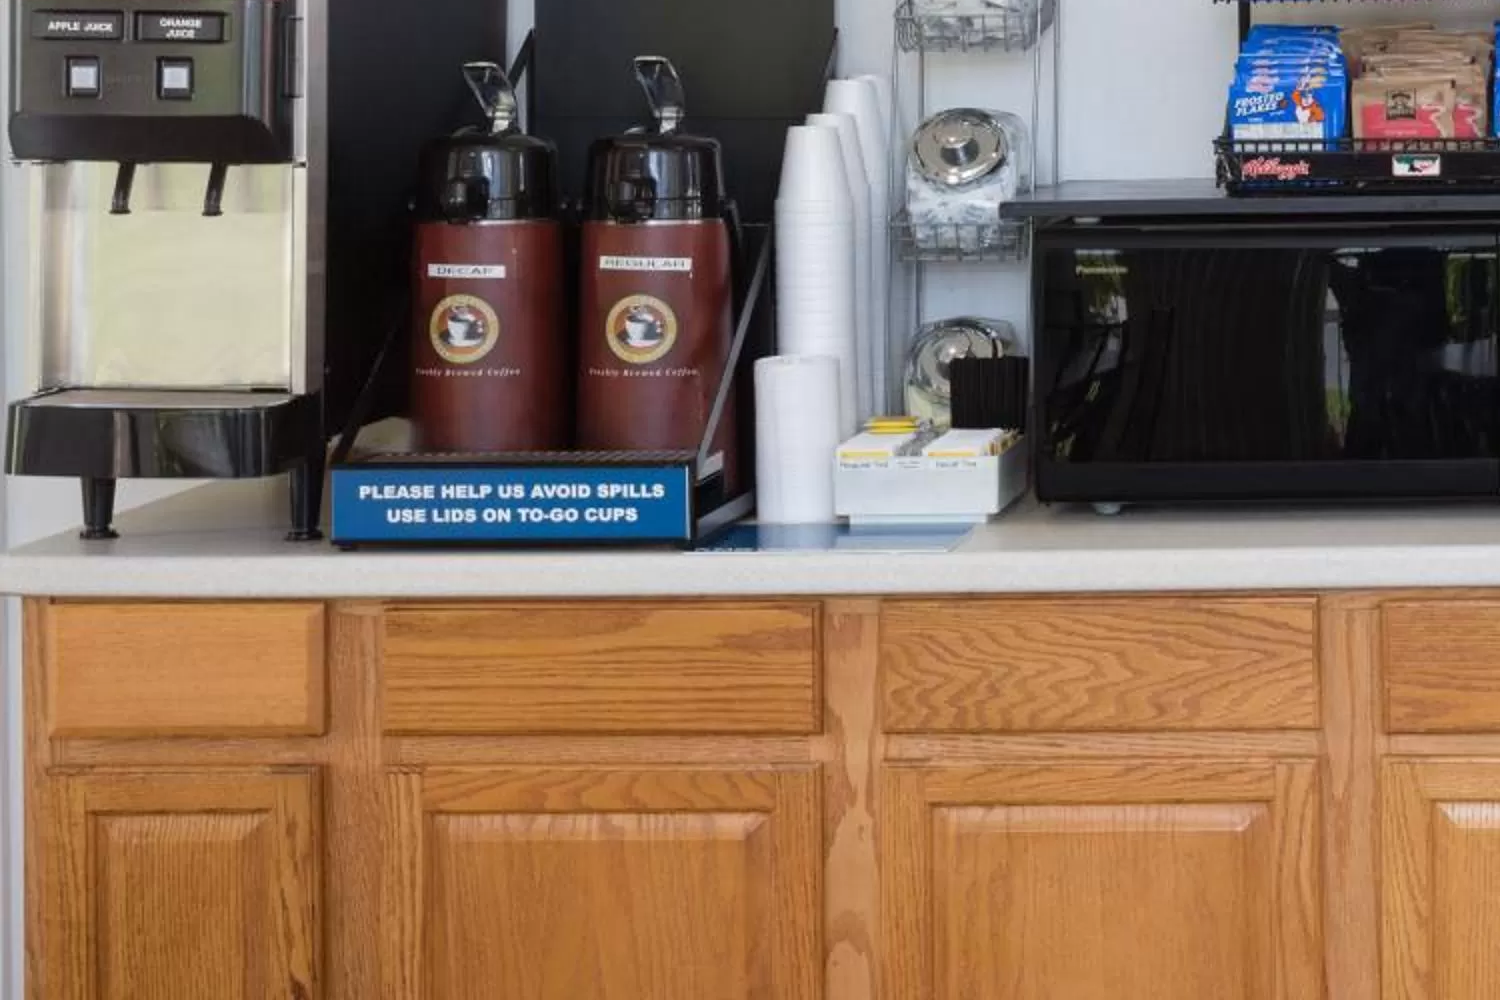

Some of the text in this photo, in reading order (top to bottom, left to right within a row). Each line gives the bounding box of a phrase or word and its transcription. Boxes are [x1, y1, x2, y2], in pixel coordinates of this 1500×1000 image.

[48, 20, 113, 33] APPLE JUICE
[436, 266, 493, 276] DECAF
[359, 483, 665, 499] PLEASE HELP US AVOID SPILLS
[387, 507, 638, 523] USE LIDS ON TO-GO CUPS
